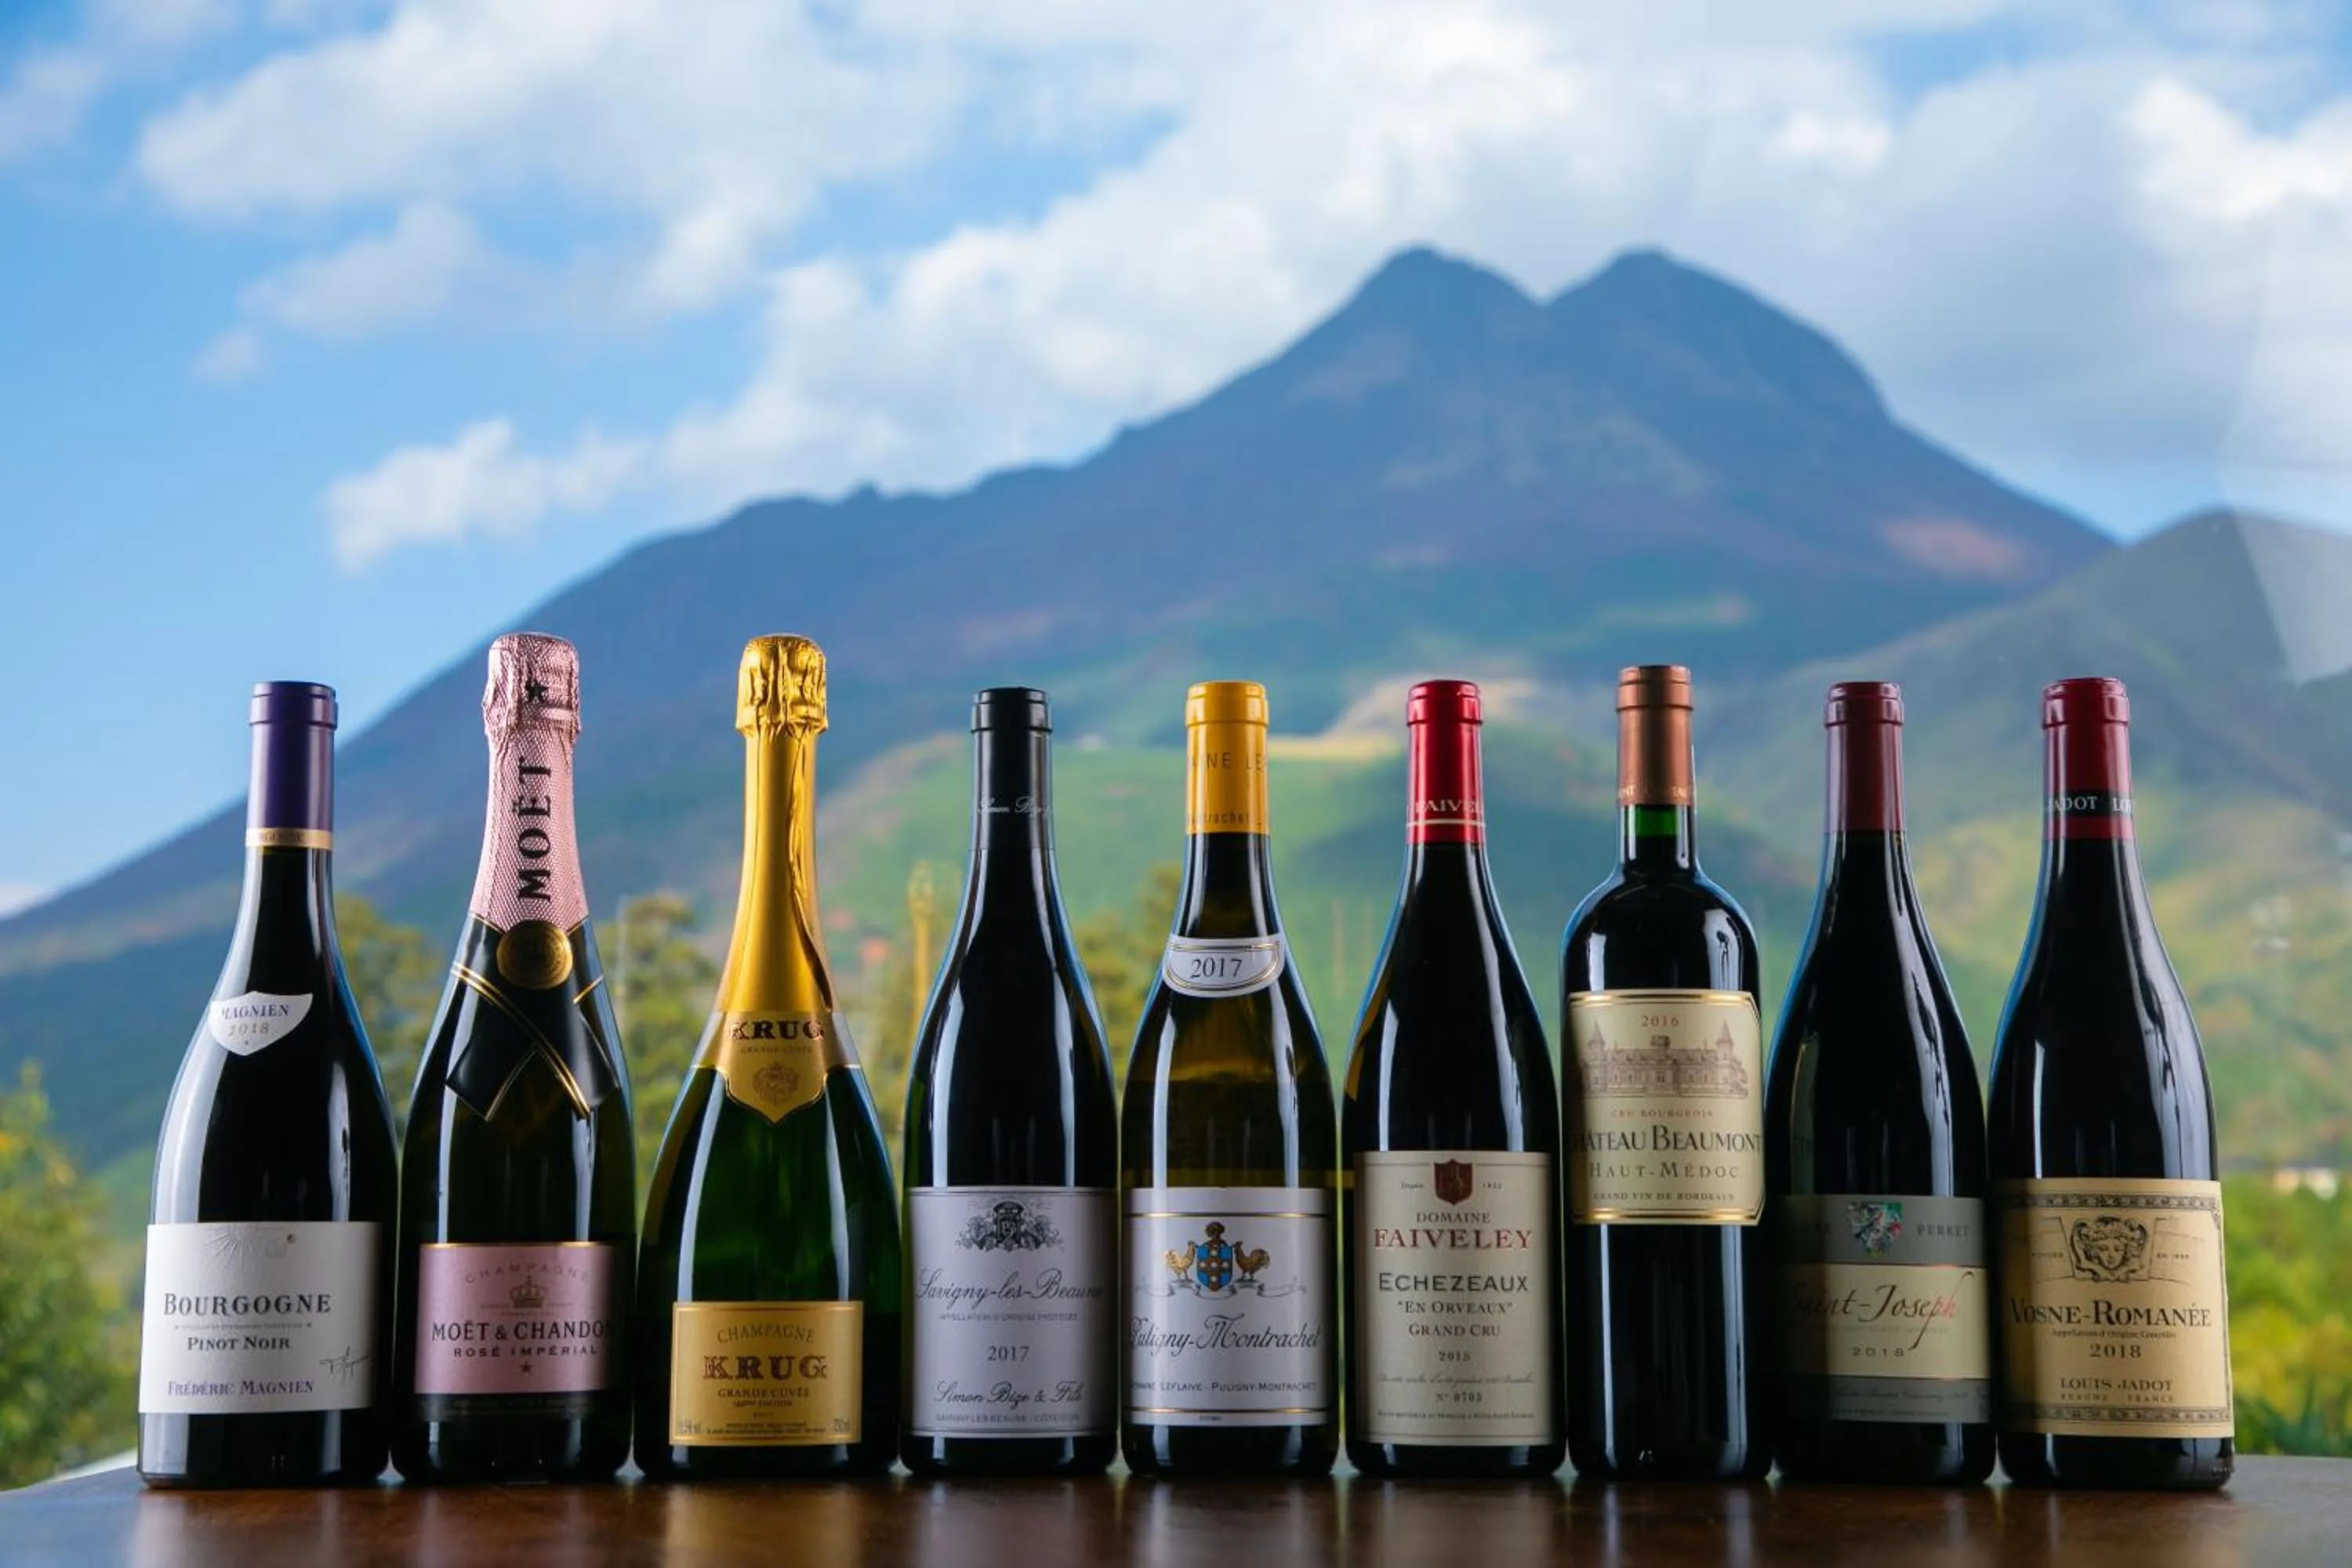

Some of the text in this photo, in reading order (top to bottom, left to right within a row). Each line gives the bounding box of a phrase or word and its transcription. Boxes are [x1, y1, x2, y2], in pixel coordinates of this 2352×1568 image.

[512, 757, 551, 903] MOËT
[1189, 956, 1243, 979] 2017
[227, 1022, 270, 1036] 2018
[730, 1020, 825, 1040] KRUG
[1642, 1014, 1679, 1028] 2016
[1652, 1124, 1762, 1152] BEAUMONT
[1416, 1212, 1491, 1225] DOMAINE
[1374, 1228, 1532, 1250] FAIVELEY
[1917, 1223, 1970, 1238] PERRET
[465, 1261, 589, 1284] CHAMPAGNE
[1378, 1272, 1530, 1292] ECHEZEAUX
[163, 1293, 332, 1316] BOURGOGNE
[1397, 1300, 1513, 1314] "EN ORVEAUX"
[2010, 1298, 2212, 1327] VOSNE-ROMANÉE
[431, 1319, 610, 1341] MOËT & CHANDO
[717, 1323, 815, 1344] CHAMPAGNE
[1408, 1323, 1501, 1337] GRAND CRU
[187, 1335, 292, 1350] PINOT NOIR
[454, 1343, 599, 1357] ROSÉ IMPÉRIAL
[2089, 1343, 2142, 1359] 2018
[987, 1345, 1029, 1362] 2017
[1852, 1347, 1904, 1357] 2018
[703, 1355, 827, 1381] KRUG
[239, 1380, 314, 1396] MAGNIEN
[934, 1380, 983, 1403] Simon
[1034, 1388, 1047, 1403] &
[1049, 1380, 1084, 1403] Fils
[2060, 1377, 2173, 1392] LOUIS JADOT
